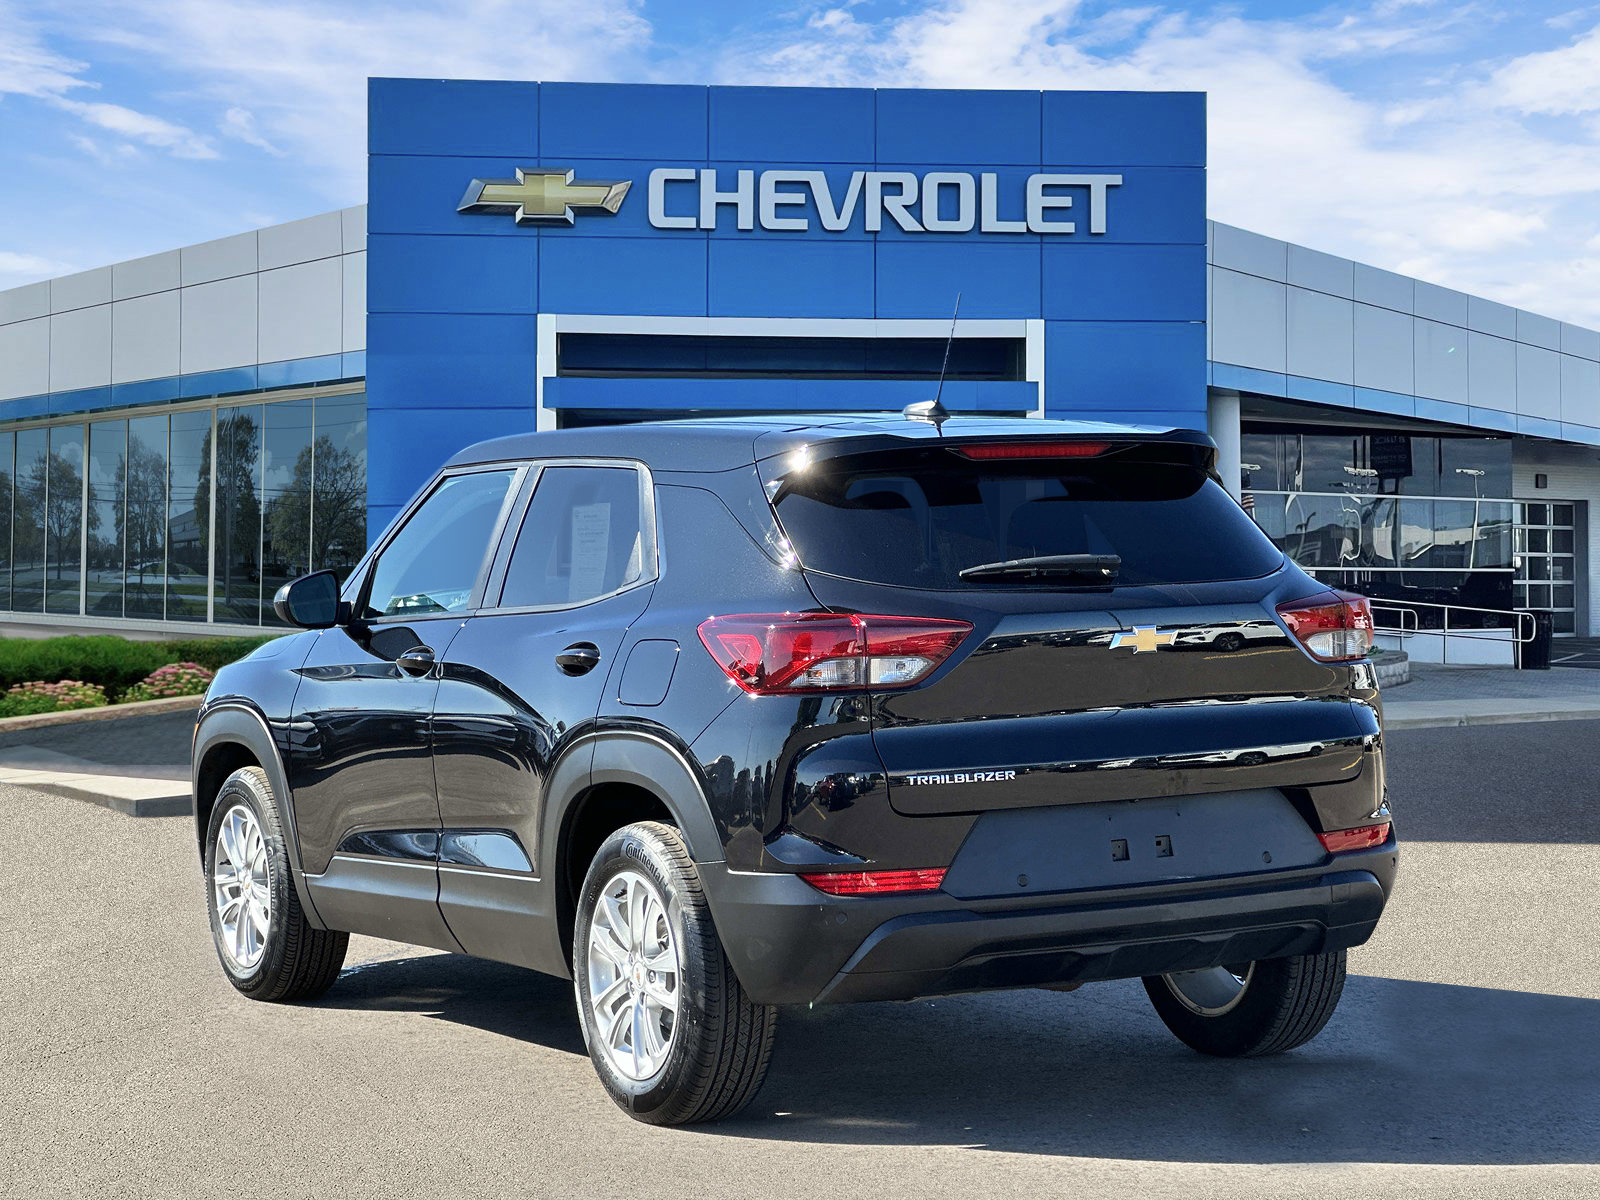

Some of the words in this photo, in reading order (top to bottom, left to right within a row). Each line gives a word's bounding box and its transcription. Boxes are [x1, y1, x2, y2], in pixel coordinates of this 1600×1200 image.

[648, 168, 1123, 234] CHEVROLET
[906, 770, 1016, 786] TRAILBLAZER
[626, 842, 665, 883] Continental
